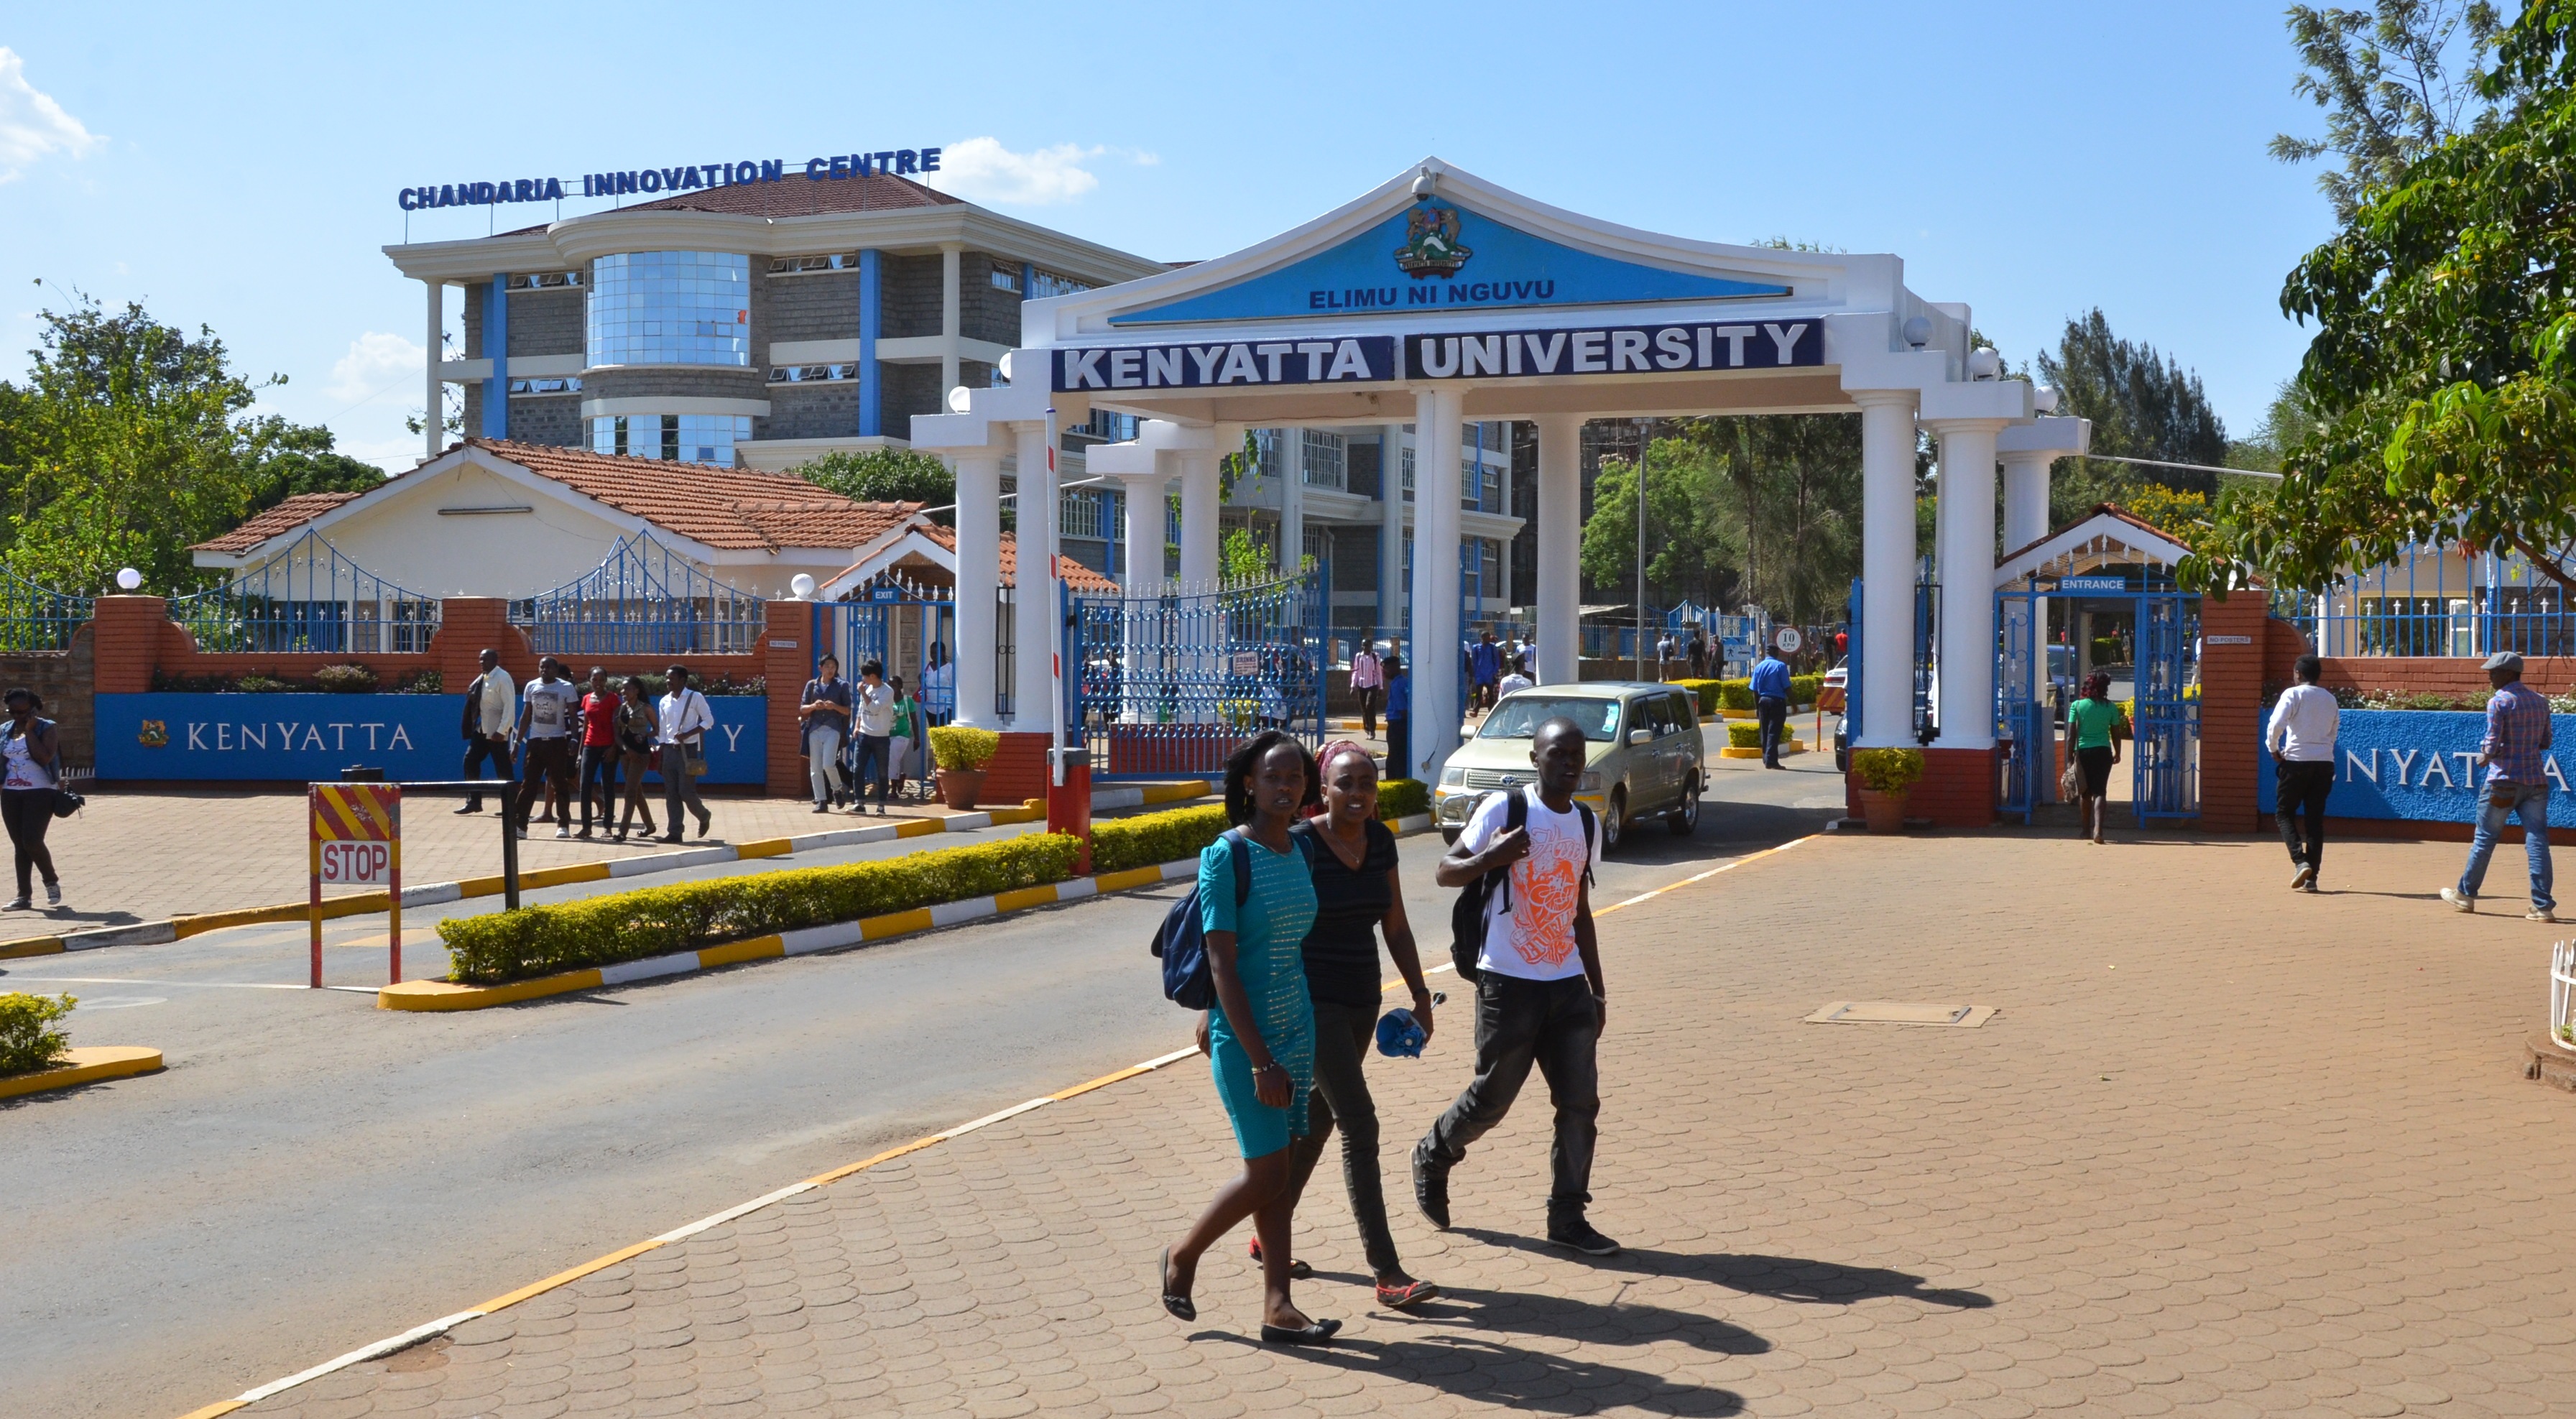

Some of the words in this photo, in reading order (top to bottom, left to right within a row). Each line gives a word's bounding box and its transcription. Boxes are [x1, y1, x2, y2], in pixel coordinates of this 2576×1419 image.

[399, 177, 564, 211] CHANDARIA
[583, 159, 783, 197] INNOVATION
[806, 147, 941, 180] CENTRE
[1310, 287, 1397, 309] ELIMU
[1408, 285, 1436, 305] NI
[1449, 280, 1554, 302] NGUVU
[1065, 340, 1372, 389] KENYATTA
[1421, 323, 1809, 377] UNIVERSITY
[875, 591, 893, 599] EXIT
[2062, 579, 2124, 589] ENTRANCE
[1783, 633, 1795, 643] 10
[188, 723, 414, 751] KENYATTA
[2345, 748, 2570, 791] NYATA
[323, 844, 387, 882] STOP
